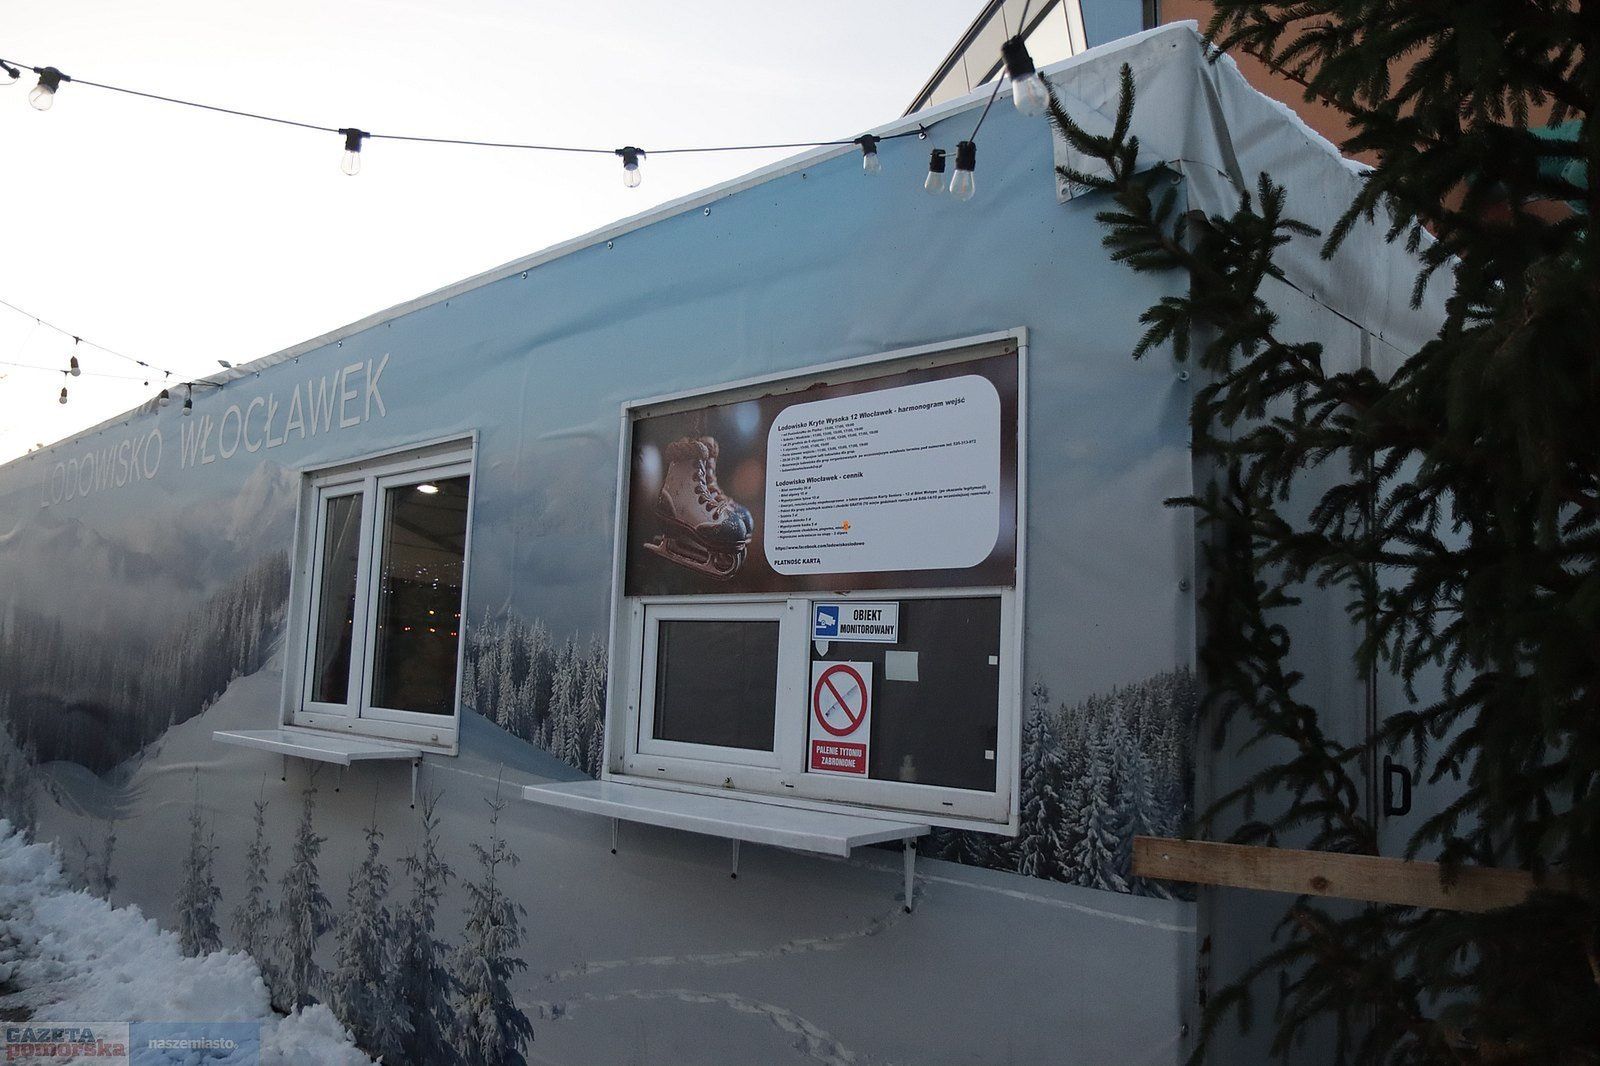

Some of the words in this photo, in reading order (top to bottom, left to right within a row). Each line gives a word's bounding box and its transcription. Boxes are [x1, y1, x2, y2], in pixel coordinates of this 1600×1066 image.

[778, 422, 807, 431] Lodowisko
[826, 415, 848, 424] Wysoka
[898, 401, 943, 413] harmonogram
[945, 397, 965, 406] wejść
[39, 429, 163, 508] LODOWISKO
[181, 352, 391, 470] WŁOCŁAWEK
[776, 478, 805, 486] Lodowisko
[853, 610, 882, 621] OBIEKT
[840, 624, 894, 635] MONITOROWANY
[816, 745, 838, 756] PALENIE
[840, 747, 862, 757] TYTONIU
[821, 756, 856, 768] ZABRONIONE
